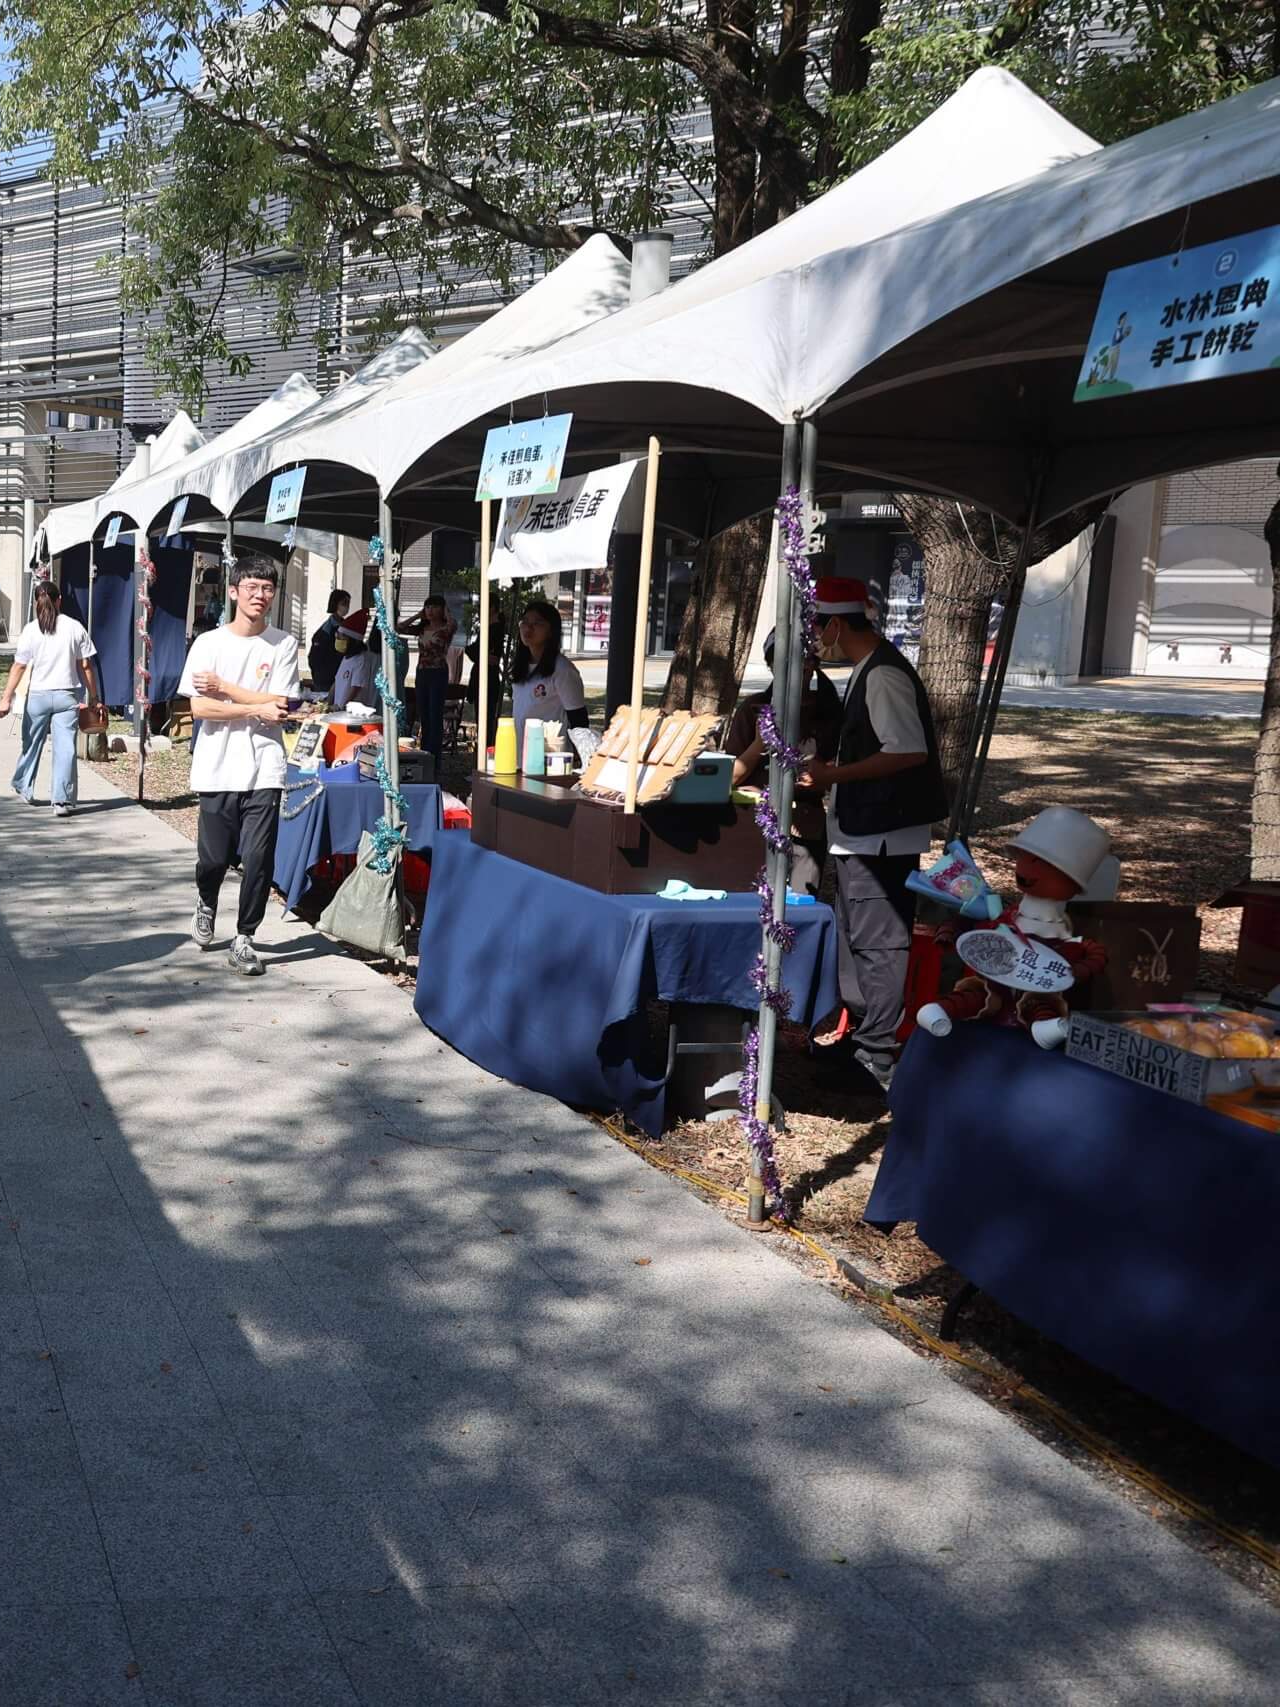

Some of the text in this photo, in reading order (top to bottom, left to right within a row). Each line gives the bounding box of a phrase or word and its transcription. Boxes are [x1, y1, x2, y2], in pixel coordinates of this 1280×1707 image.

[1218, 253, 1234, 272] 2
[1159, 277, 1270, 329] 水林恩典
[1149, 320, 1259, 368] 手工餅乾
[1015, 948, 1068, 978] 恩典
[1070, 1026, 1105, 1052] EAT
[1117, 1031, 1183, 1069] ENJOY
[1125, 1055, 1180, 1094] SERVE
